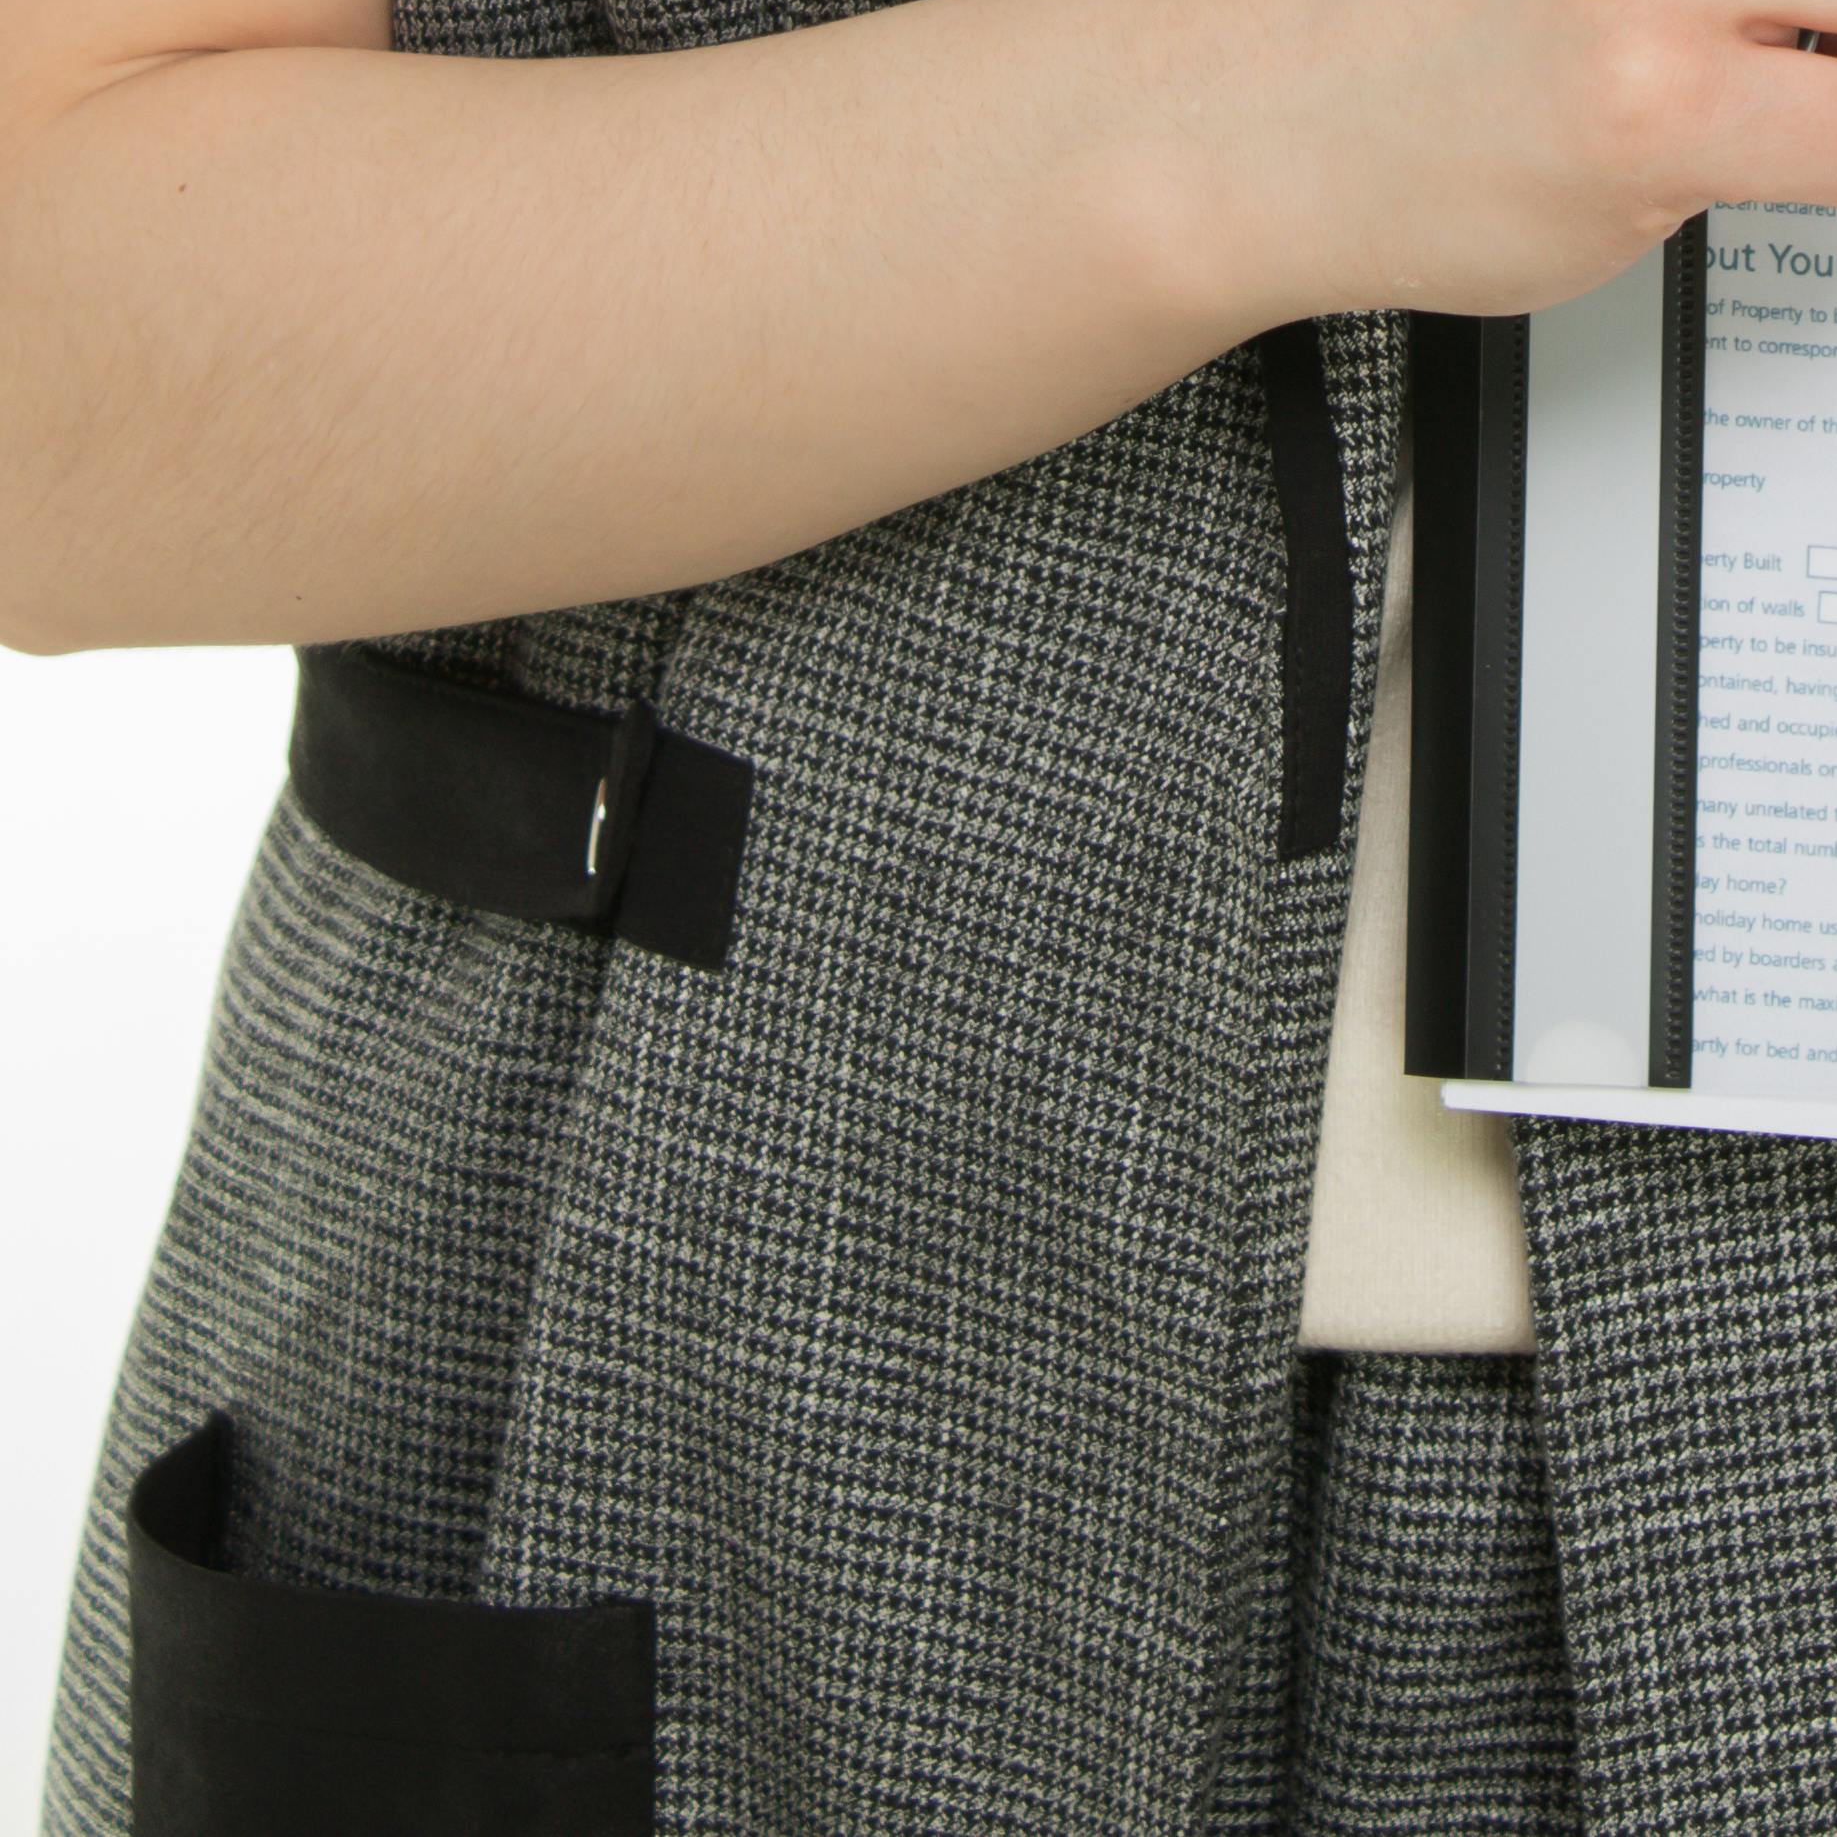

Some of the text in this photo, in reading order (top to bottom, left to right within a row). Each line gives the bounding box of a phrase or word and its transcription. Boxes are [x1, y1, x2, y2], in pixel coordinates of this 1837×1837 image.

[1731, 299, 1804, 326] Property
[1809, 307, 1828, 323] to
[1733, 335, 1753, 352] to
[1734, 414, 1792, 431] owner
[1796, 414, 1816, 433] of
[1744, 801, 1828, 822] unrelated
[1721, 945, 1744, 969] by
[1748, 947, 1827, 972] boarders
[1734, 1037, 1761, 1057] for
[1765, 1040, 1801, 1060] bed
